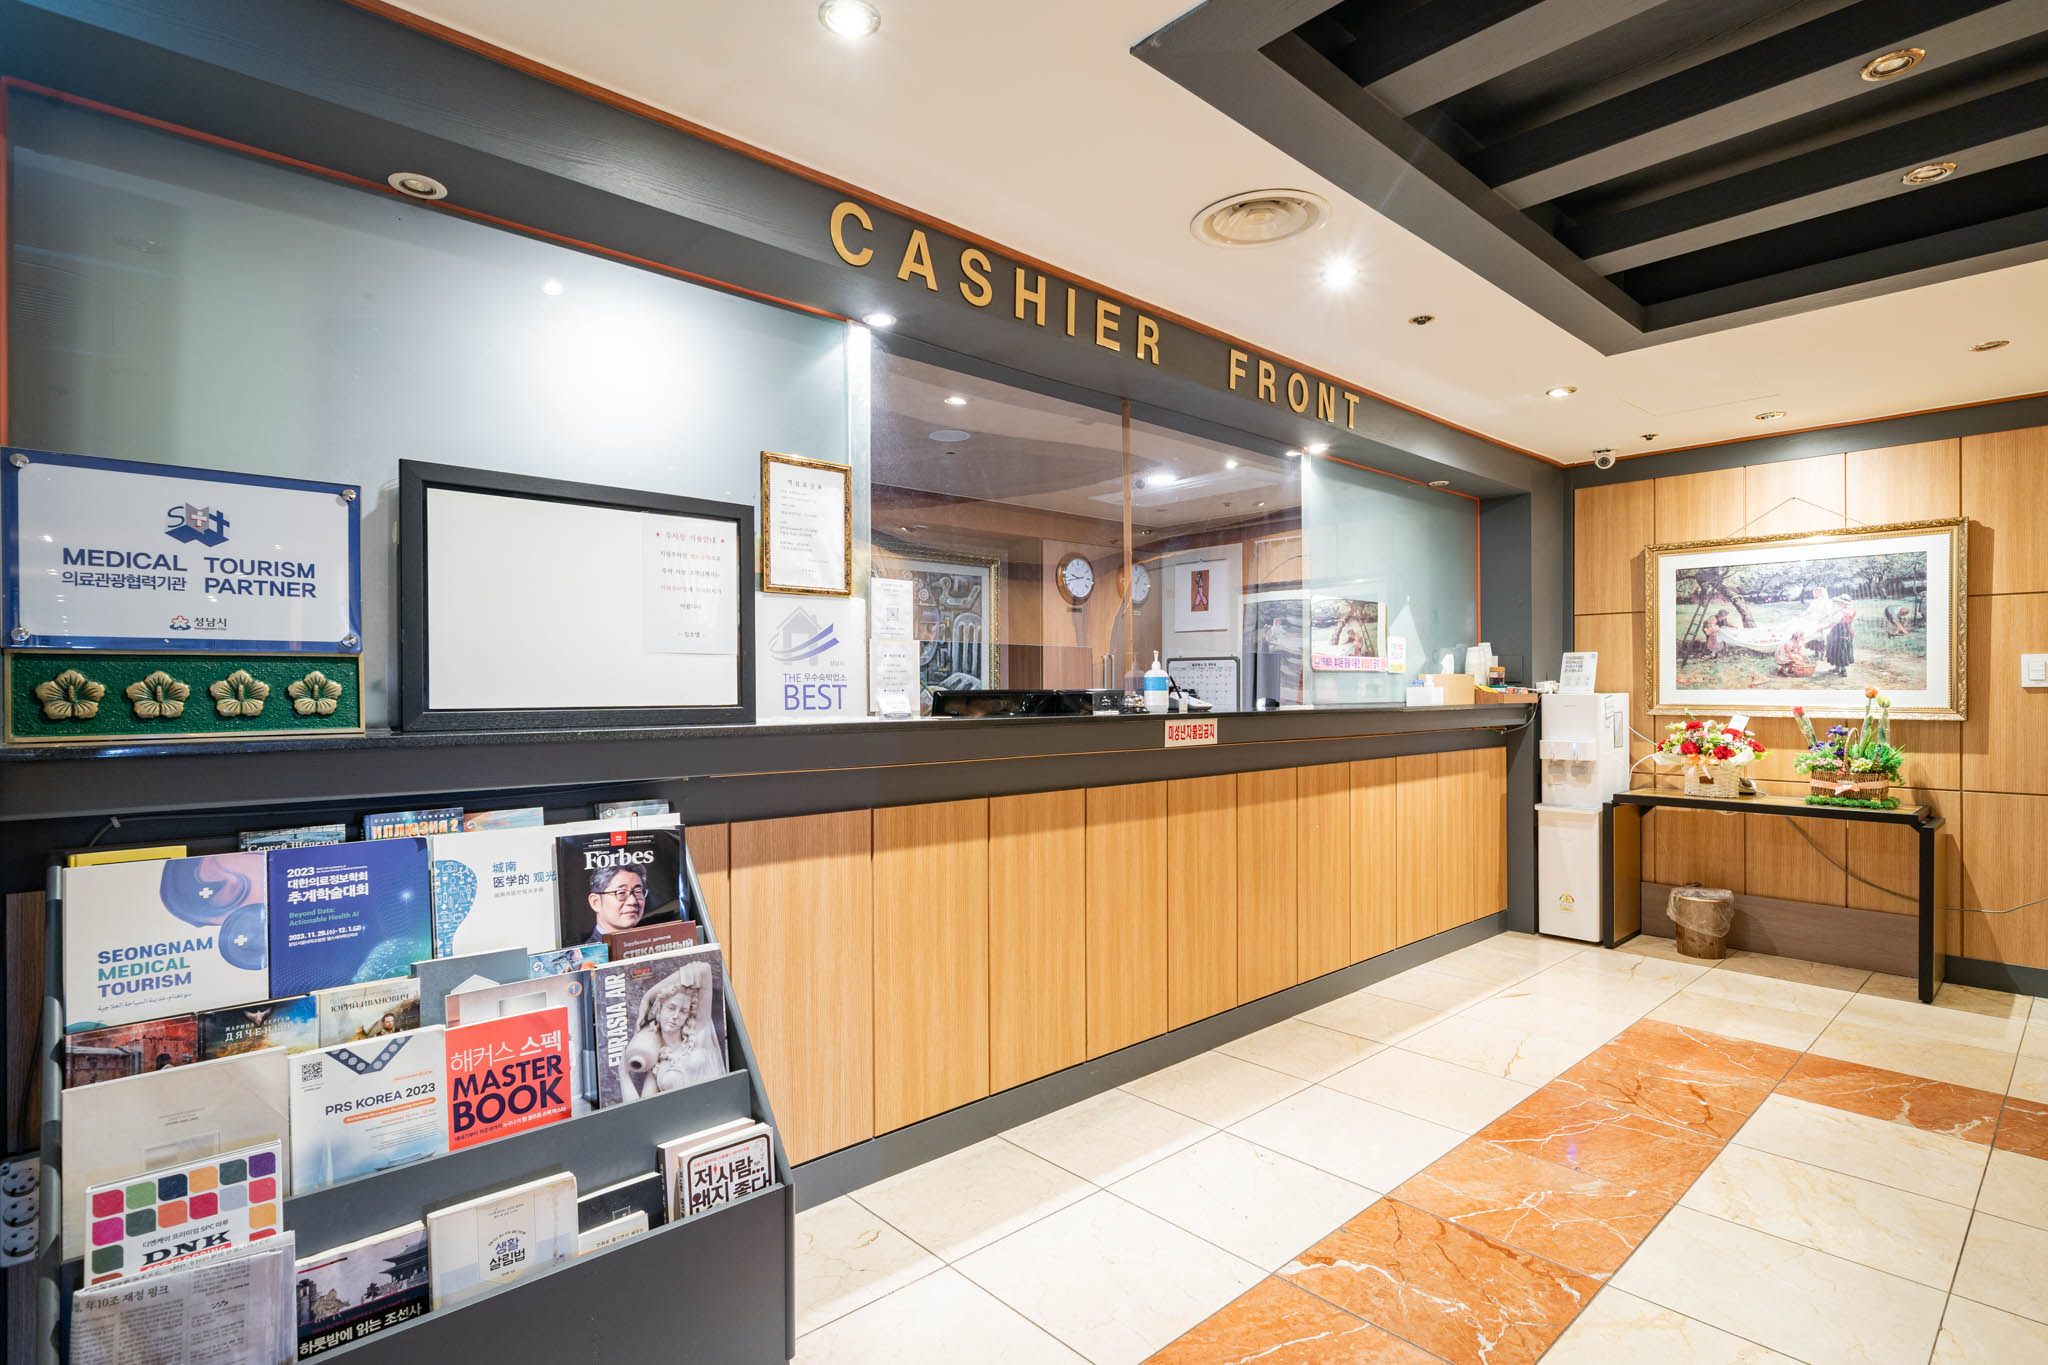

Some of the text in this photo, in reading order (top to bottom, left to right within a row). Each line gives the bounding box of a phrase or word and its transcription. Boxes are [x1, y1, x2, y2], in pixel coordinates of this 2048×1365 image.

[829, 201, 1360, 429] CASHIER FRONT
[62, 547, 316, 579] MEDICAL TOURISM
[61, 570, 188, 592] 의료관광협력기관
[204, 576, 317, 598] PARTNER
[193, 616, 228, 628] 성남시
[783, 672, 848, 683] THE 우수숙박업소
[783, 684, 848, 711] BEST
[1168, 723, 1215, 741] 미성년자출입금지
[449, 818, 459, 833] 2
[493, 861, 518, 873] 城南
[584, 847, 655, 871] Forbes
[287, 866, 315, 878] 2023
[287, 871, 369, 889] 대한의료정보학회
[493, 874, 530, 888] 医学的
[287, 883, 369, 905] 추계학술대회
[289, 908, 316, 920] Beyond
[289, 915, 328, 927] Actionable
[328, 911, 351, 921] Health
[98, 936, 212, 965] SEONGNAM
[98, 956, 191, 982] MEDICAL
[97, 971, 192, 998] TOURISM
[225, 1023, 255, 1032] МАРИНА
[604, 972, 629, 1068] EURASIA AIR
[450, 1029, 562, 1072] 해커스 스펙
[453, 1054, 564, 1102] MASTER
[325, 1101, 353, 1116] PRS
[356, 1090, 403, 1109] KOREA
[405, 1082, 436, 1098] 2023
[453, 1076, 565, 1134] BOOK
[694, 1165, 713, 1187] 저
[200, 1223, 215, 1233] SPC
[143, 1229, 232, 1266] DNK
[496, 1237, 520, 1255] 생활
[489, 1248, 526, 1272] 살림법
[299, 1326, 353, 1355] 하룻밤에
[356, 1318, 382, 1337] 읽는
[384, 1302, 422, 1327] 조선사
